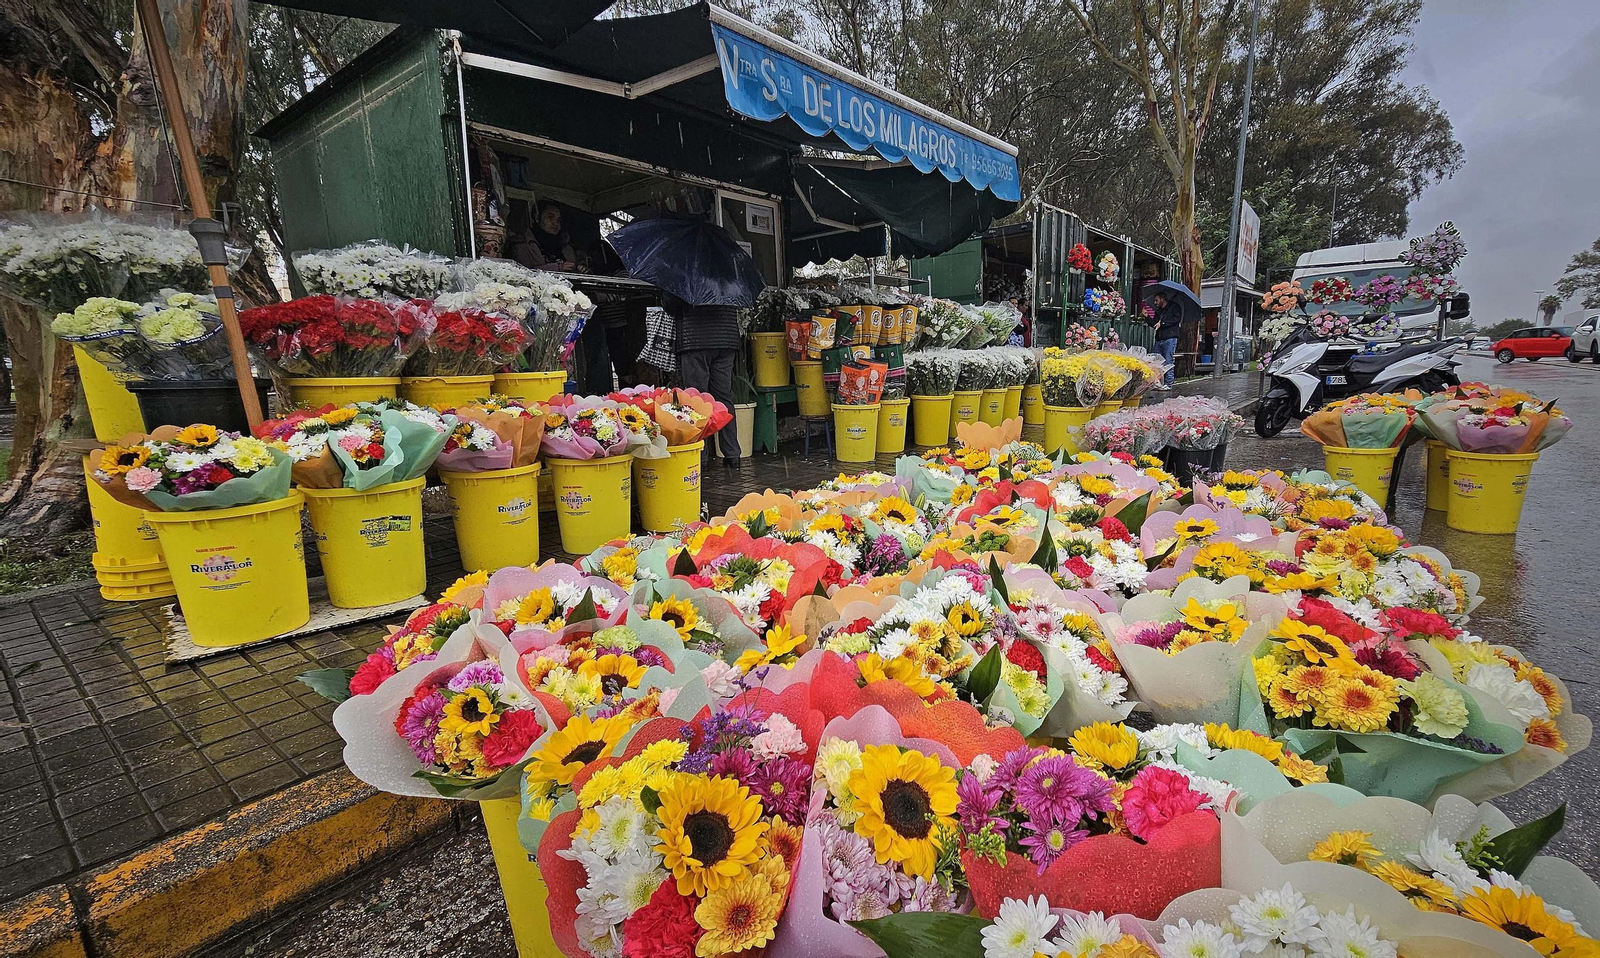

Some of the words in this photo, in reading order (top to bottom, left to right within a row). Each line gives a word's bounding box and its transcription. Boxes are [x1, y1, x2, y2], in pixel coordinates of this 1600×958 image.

[803, 75, 832, 123] DE
[837, 89, 876, 138] LOS
[879, 108, 956, 168] MILAGROS
